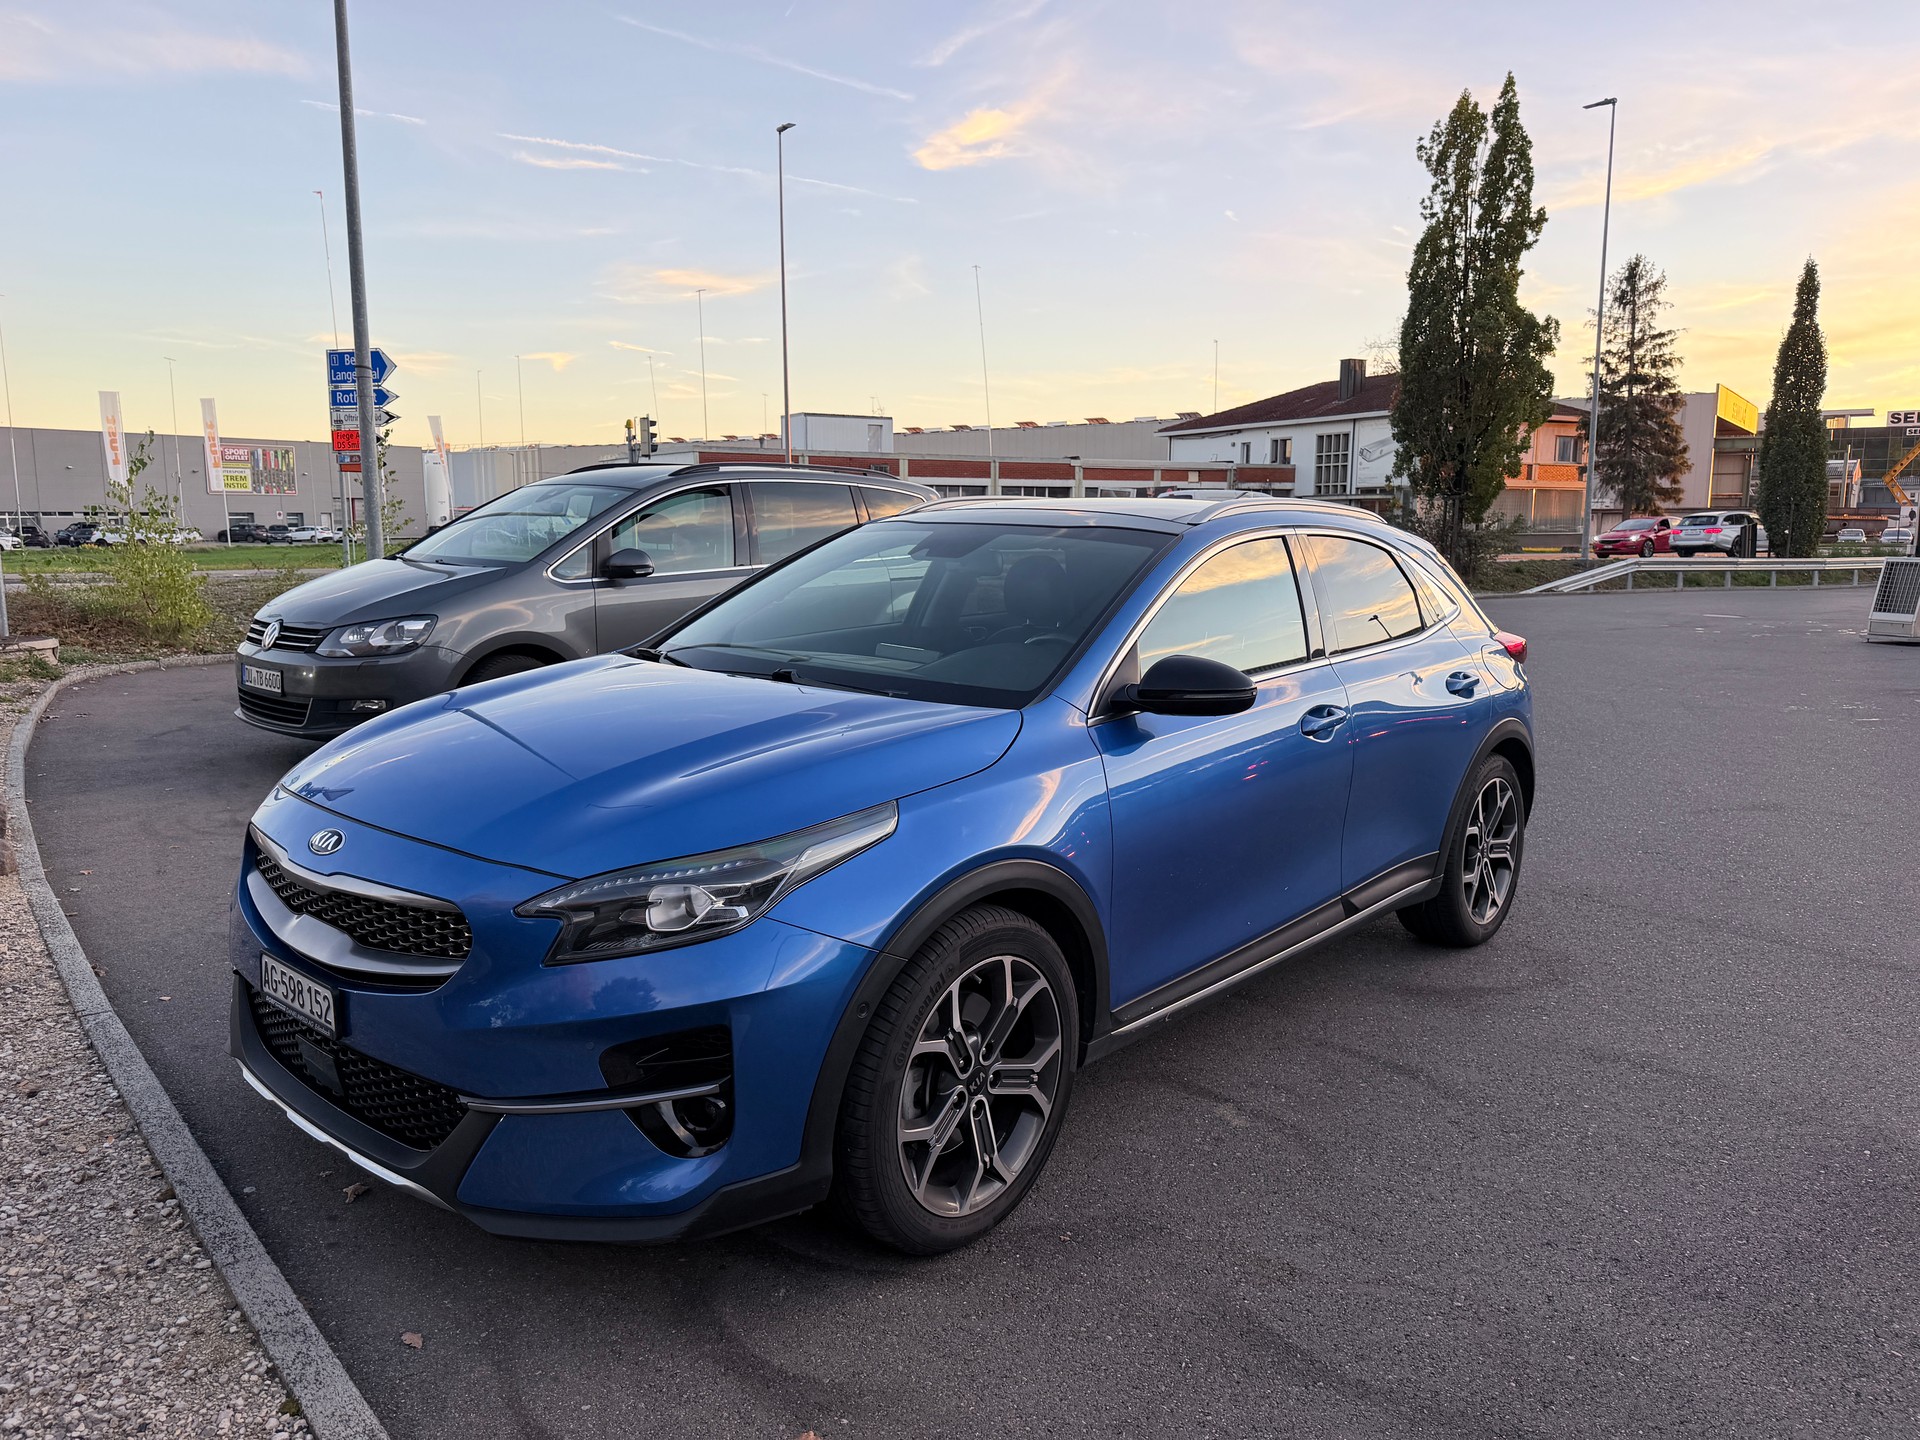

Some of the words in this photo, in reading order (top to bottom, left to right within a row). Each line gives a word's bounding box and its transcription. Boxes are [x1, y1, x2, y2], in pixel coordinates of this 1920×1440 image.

[331, 367, 380, 383] Langeal
[1890, 412, 1920, 424] SE
[224, 448, 248, 456] SPORT
[337, 441, 346, 449] DS
[312, 830, 339, 851] KIA
[306, 985, 333, 1026] 152
